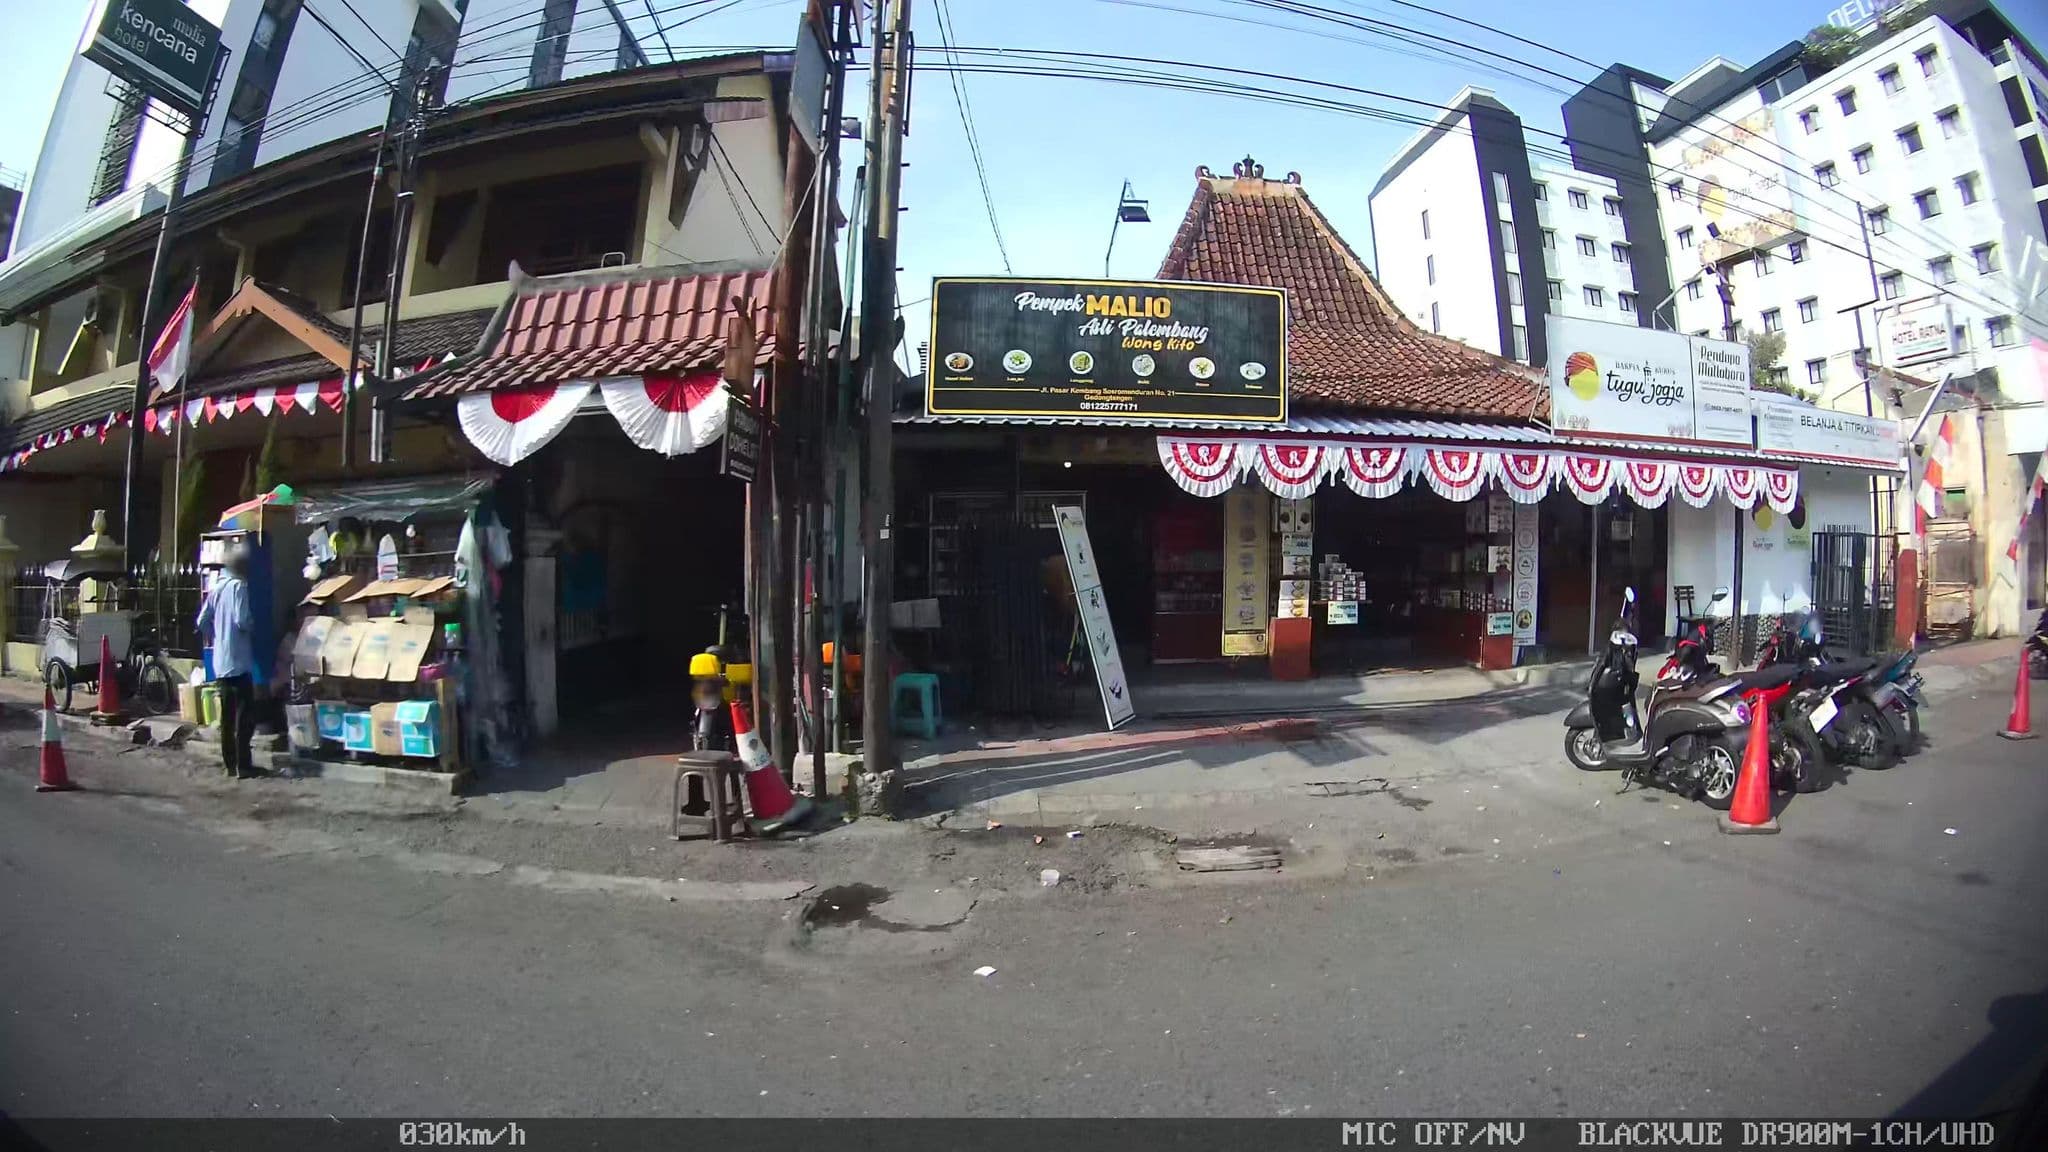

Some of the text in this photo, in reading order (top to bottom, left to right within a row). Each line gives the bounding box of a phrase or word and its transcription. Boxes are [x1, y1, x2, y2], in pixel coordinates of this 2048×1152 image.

[113, 24, 149, 55] hotel
[120, 0, 198, 64] kencana
[172, 17, 206, 47] mulia
[1014, 292, 1172, 318] Pempek MALIO
[1079, 318, 1209, 344] Asli Palembang
[1121, 336, 1195, 351] Wong Kito
[1892, 330, 1918, 345] HOTEL
[1606, 370, 1685, 407] tugu jogja
[1080, 402, 1138, 411] 081225777171
[1801, 415, 1836, 432] BELANJA
